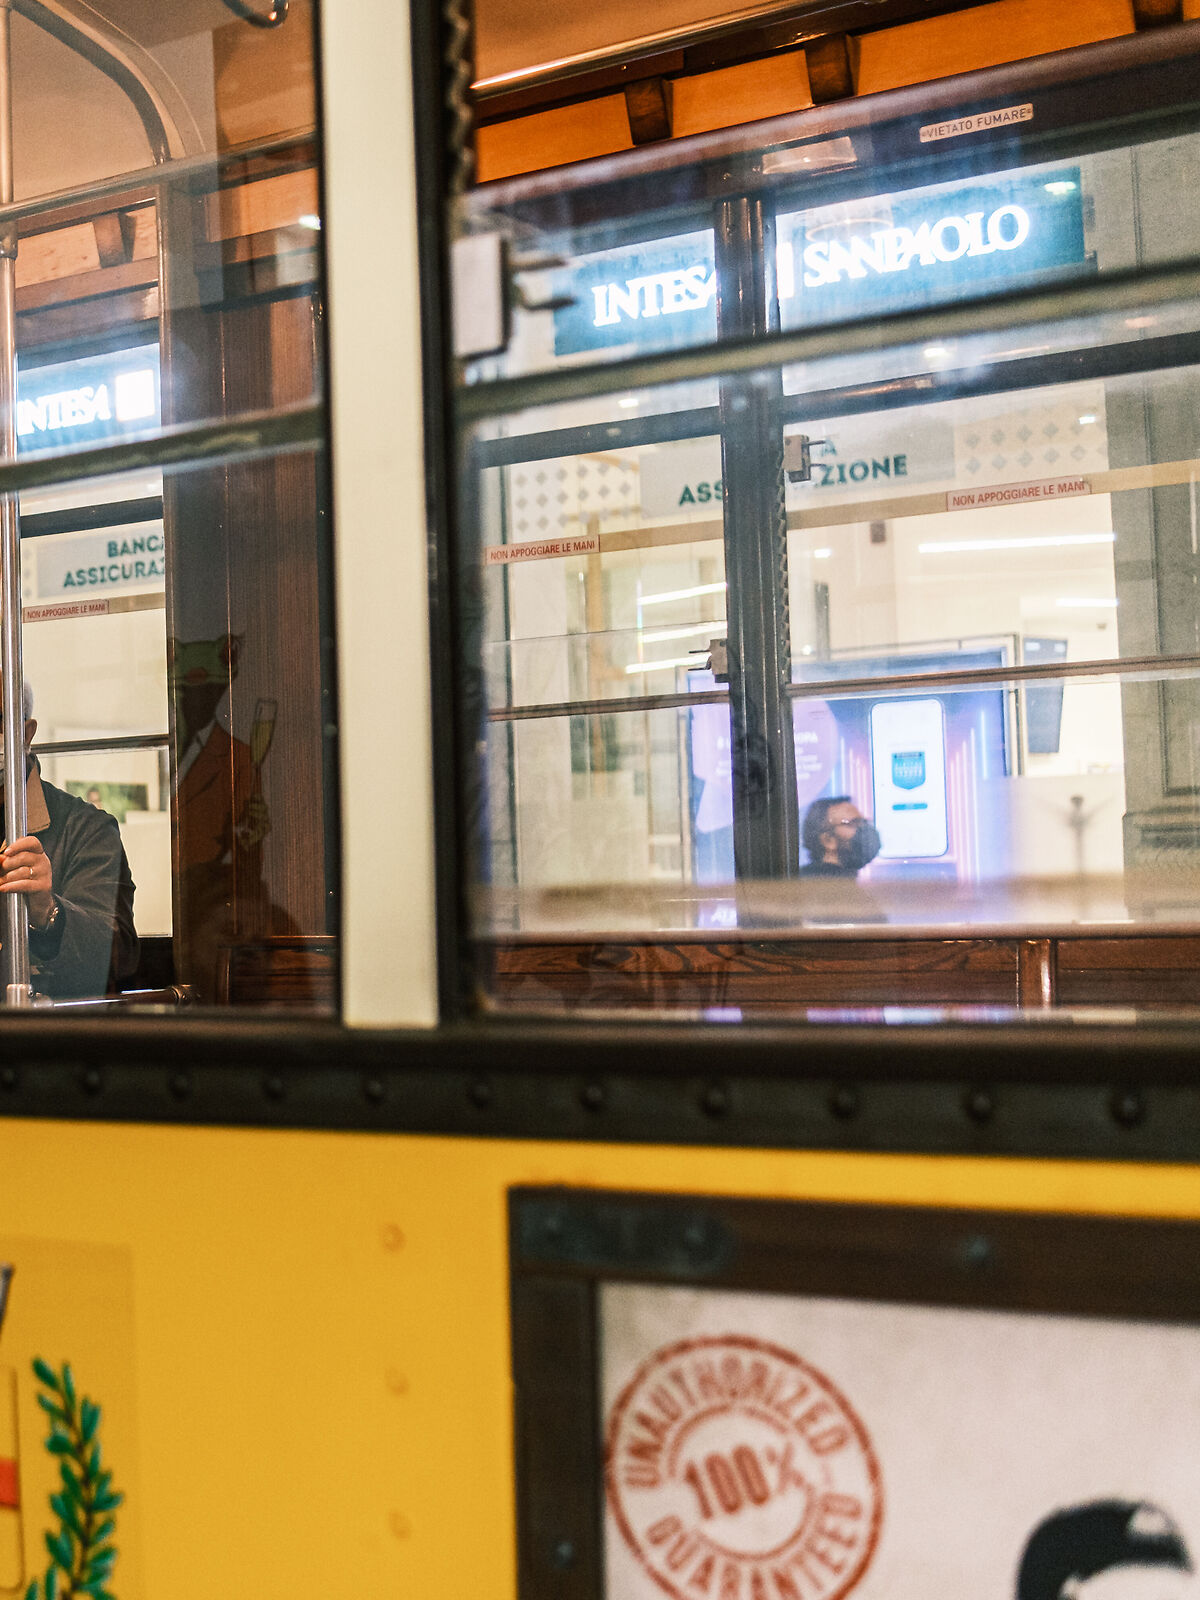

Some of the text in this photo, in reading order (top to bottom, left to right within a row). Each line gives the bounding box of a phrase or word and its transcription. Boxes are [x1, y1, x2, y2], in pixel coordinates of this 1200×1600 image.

[926, 107, 1027, 138] VIETATO FUMARE
[803, 204, 1031, 288] SANPAOLO
[952, 480, 1086, 507] NON APPOGGIARE LE MANI
[490, 540, 596, 561] NON APPOGGIARE LE MANI
[27, 609, 41, 619] NON
[42, 605, 79, 617] APPOGGIARE
[80, 605, 88, 613] LE
[624, 1355, 850, 1490] UNAUTHORIZED
[683, 1443, 809, 1520] 100%
